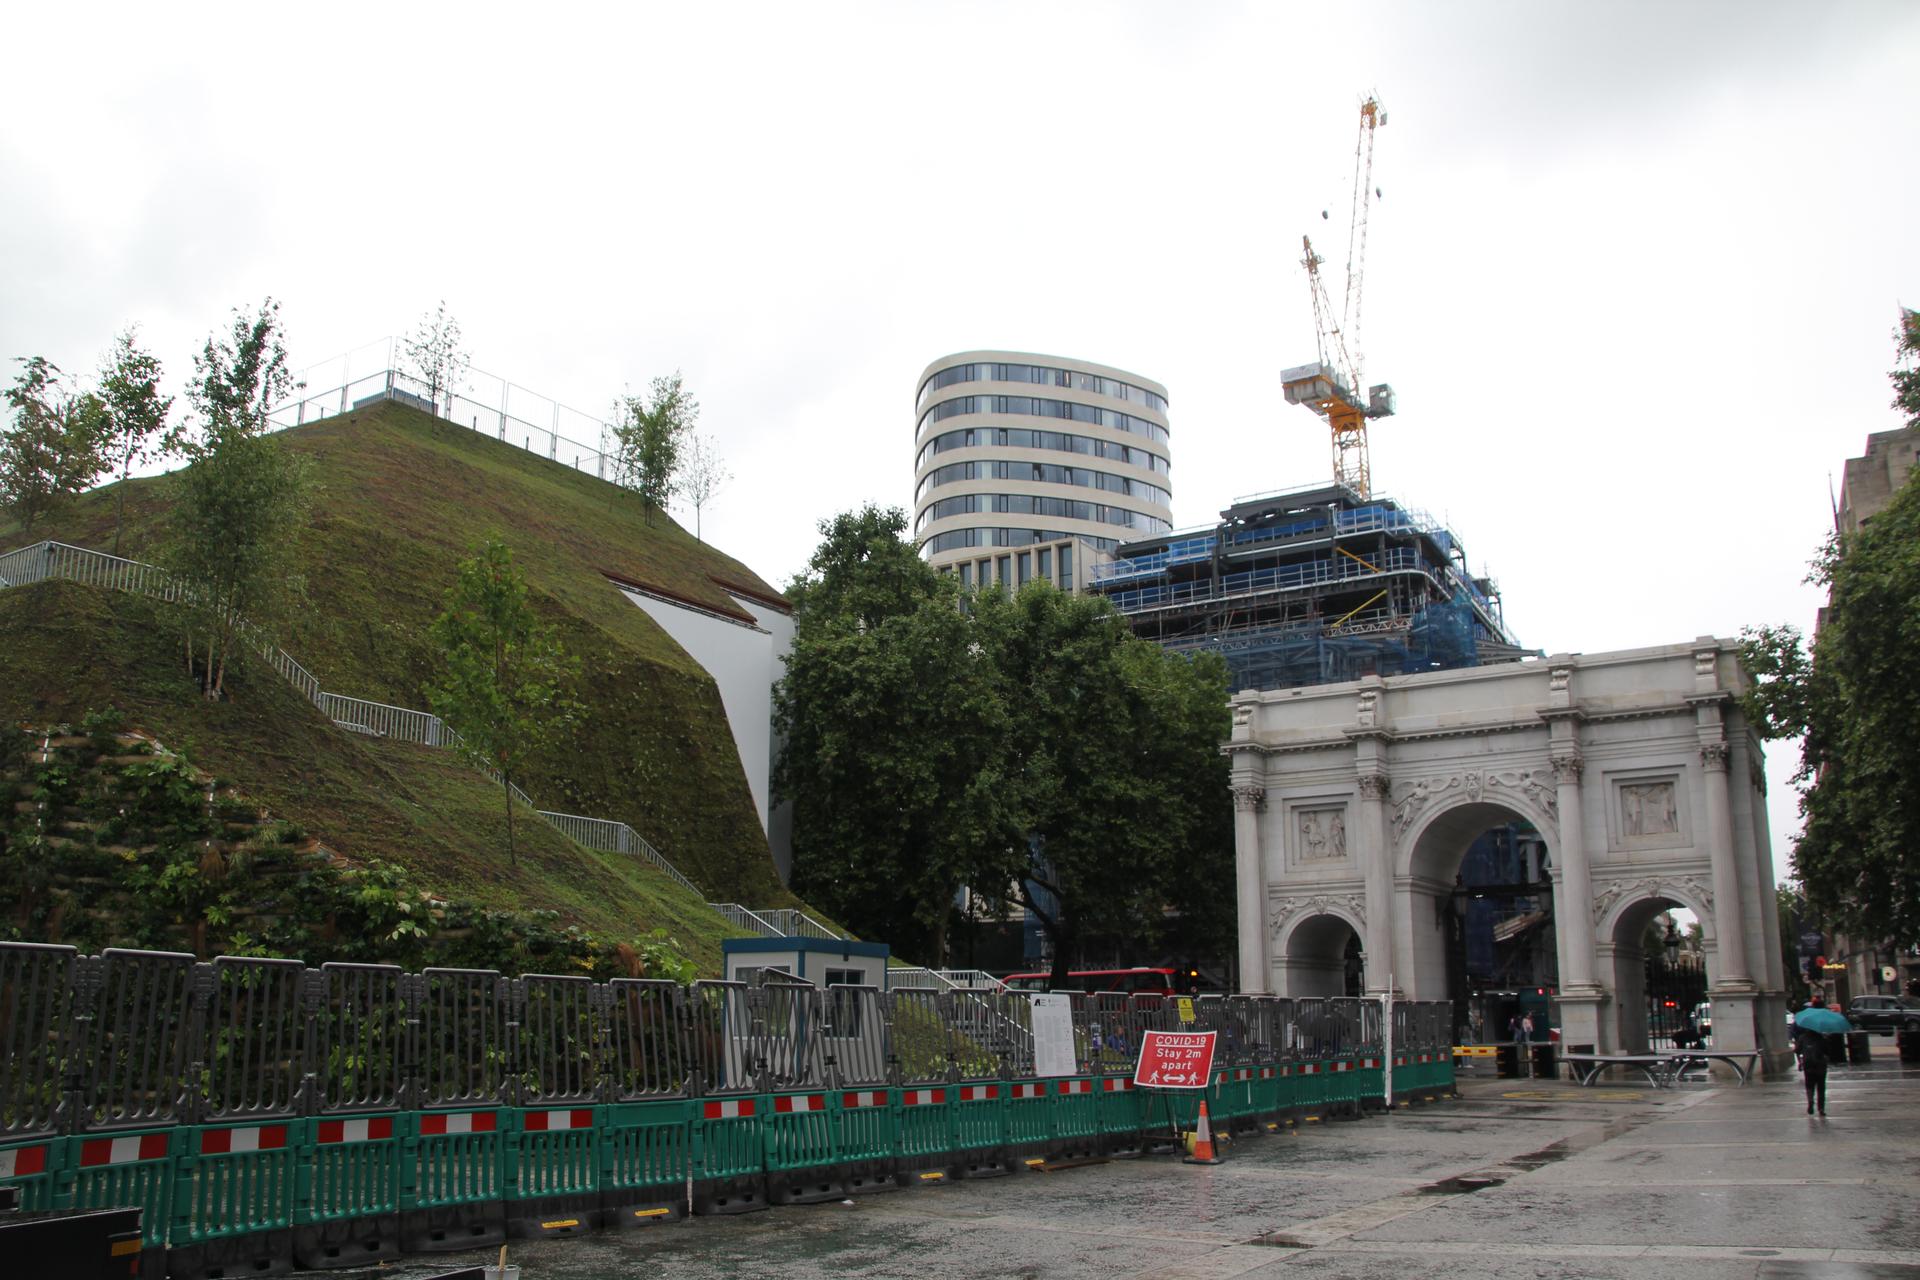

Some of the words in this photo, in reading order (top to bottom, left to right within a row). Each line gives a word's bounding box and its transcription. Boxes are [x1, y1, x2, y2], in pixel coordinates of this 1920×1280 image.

[1156, 1036, 1206, 1045] COVID-19
[1156, 1048, 1182, 1059] Stay
[1186, 1049, 1201, 1058] 2m
[1161, 1061, 1193, 1071] apart
